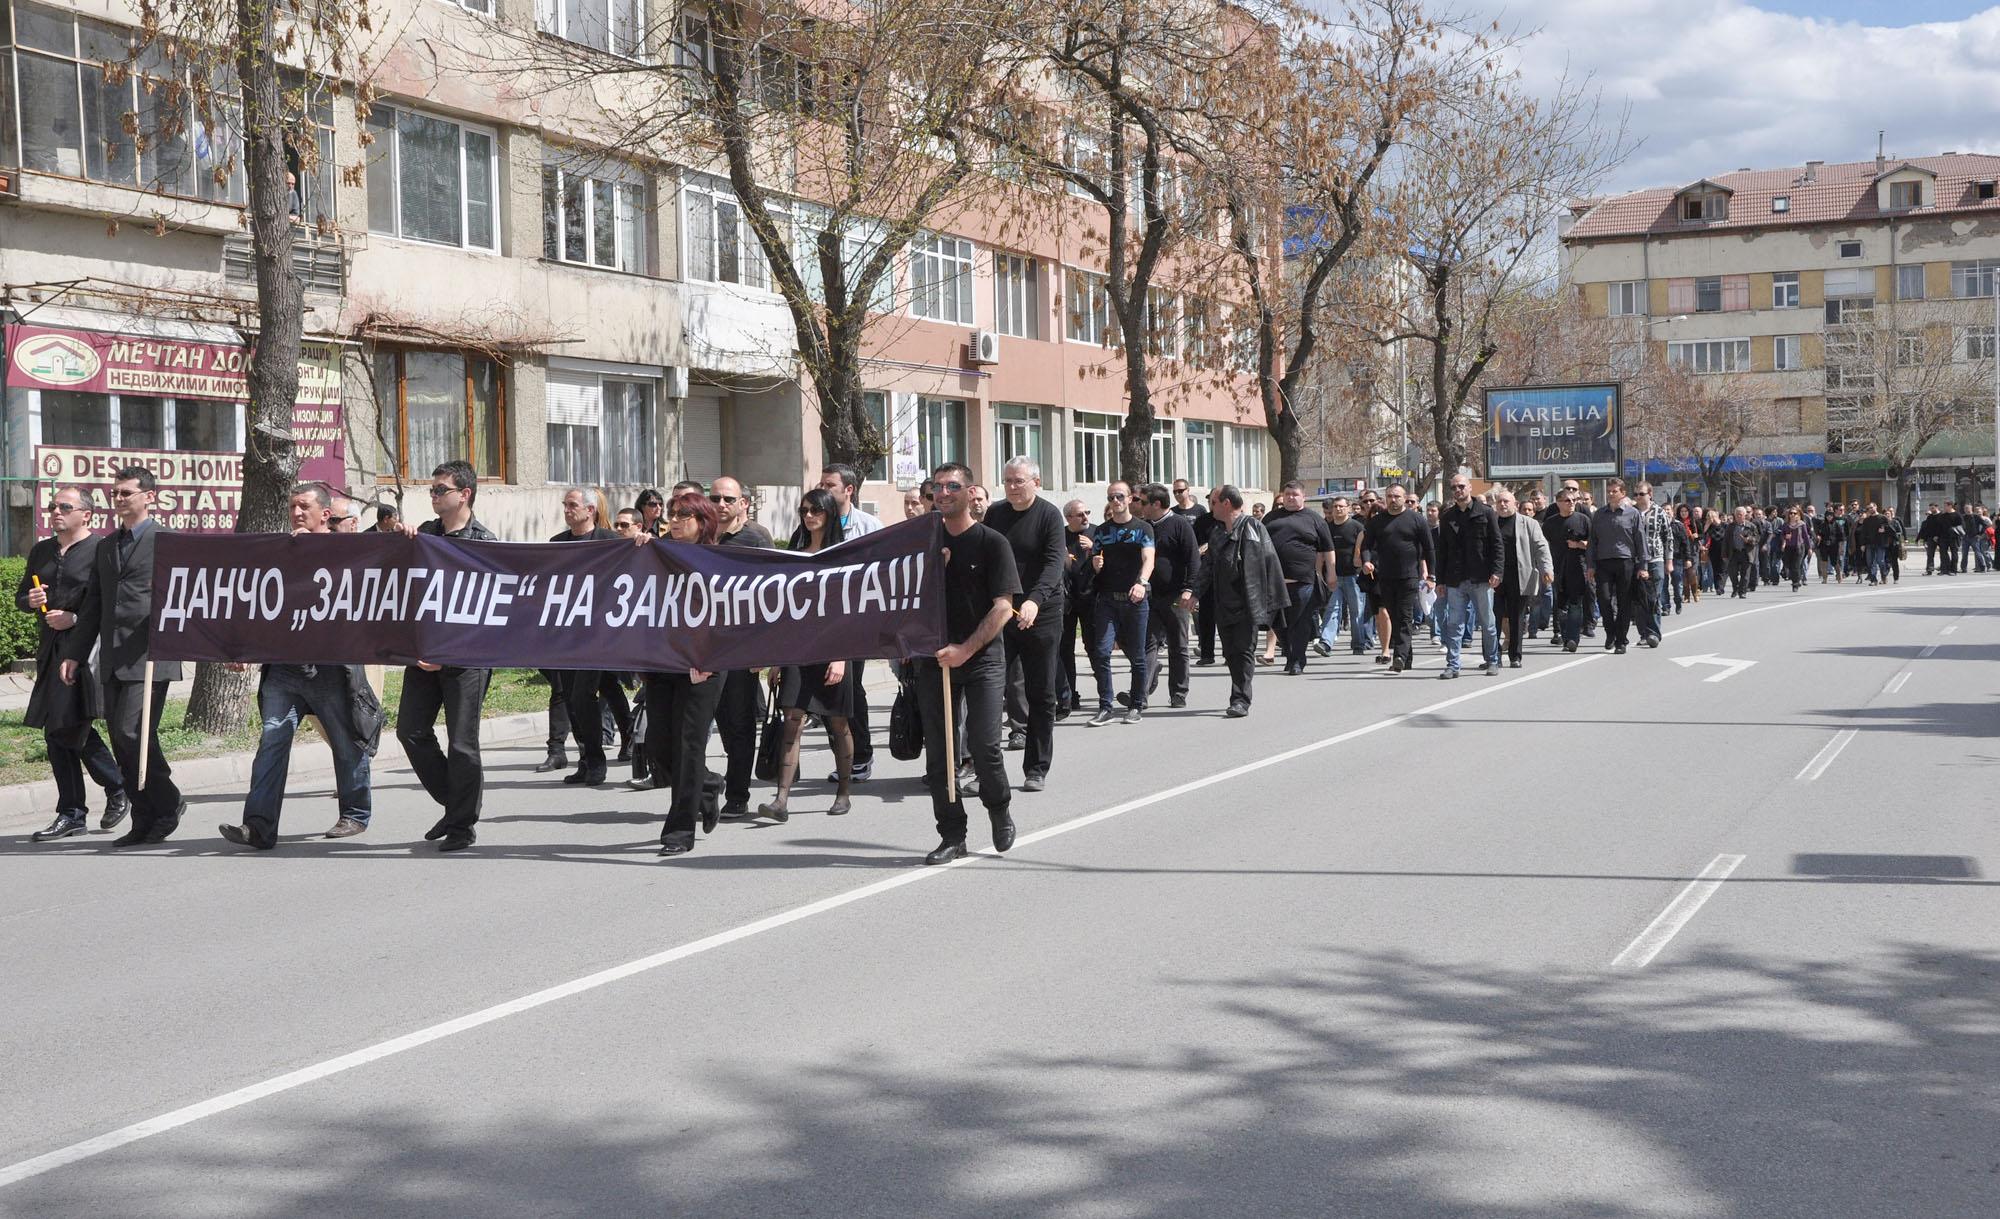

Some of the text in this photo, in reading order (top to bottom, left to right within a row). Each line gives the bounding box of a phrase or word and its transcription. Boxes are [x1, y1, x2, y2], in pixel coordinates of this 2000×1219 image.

[107, 339, 205, 369] МЕЧТАН
[299, 346, 331, 361] РАЦИИ
[297, 366, 315, 379] ОНТ
[110, 372, 250, 394] НЕДВИЖИМИ ИМОТ
[300, 386, 340, 400] ТРУКЦИИ
[1506, 405, 1601, 423] KARELIA
[1530, 427, 1575, 437] BLUE
[1537, 447, 1569, 460] 100's
[169, 513, 199, 529] 0879
[202, 514, 216, 529] 86
[219, 514, 233, 529] 86
[158, 551, 925, 632] ДАНЧО „ЗАЛАГАШЕ“ НА ЗАКОННОСТТА!!!
